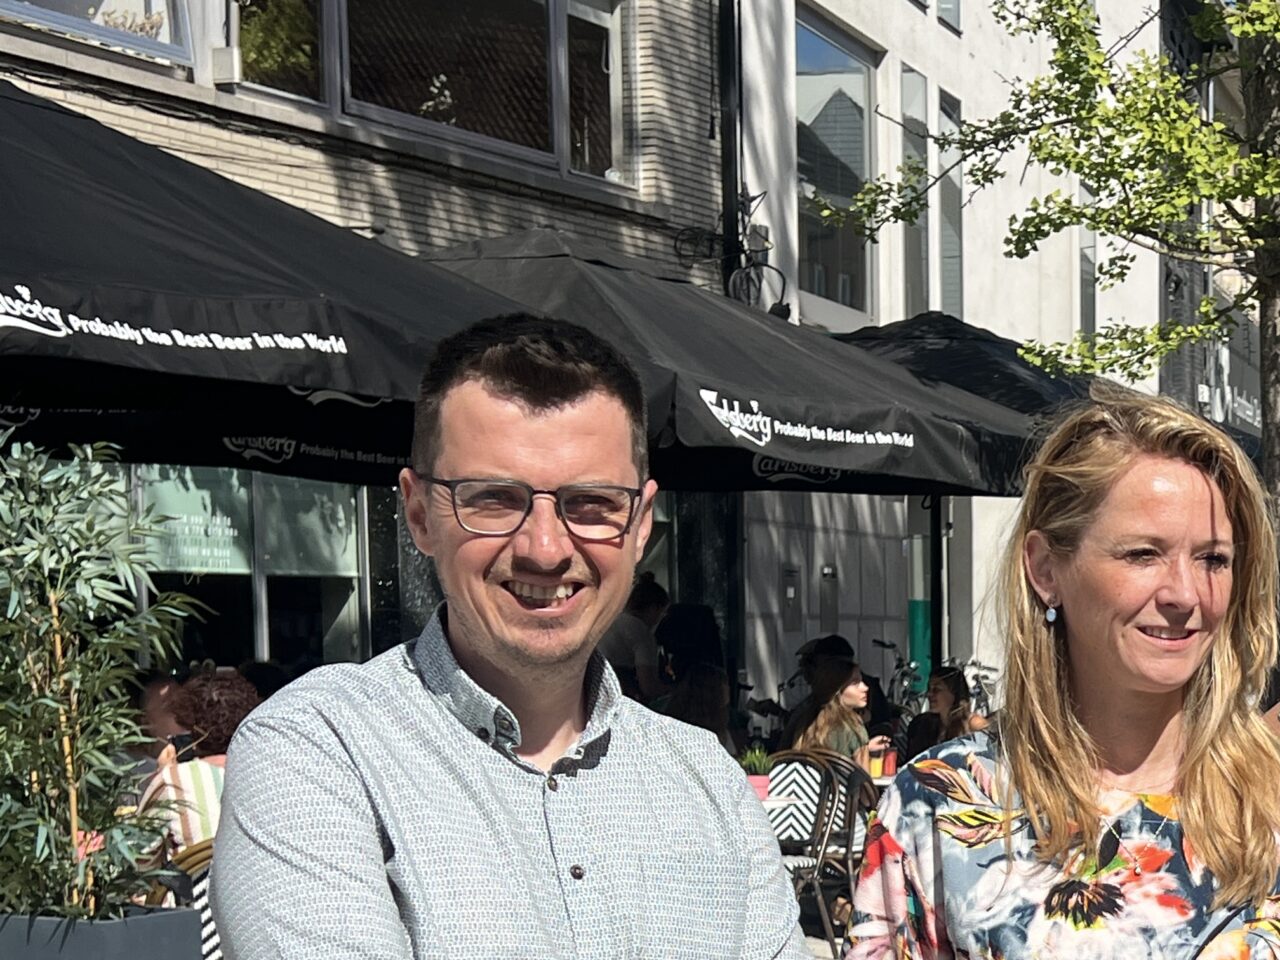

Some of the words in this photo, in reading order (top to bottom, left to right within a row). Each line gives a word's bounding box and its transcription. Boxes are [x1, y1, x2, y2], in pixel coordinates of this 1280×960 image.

[68, 314, 144, 345] Probably
[142, 327, 173, 345] the
[171, 329, 213, 347] Best
[210, 333, 252, 350] Beer
[253, 332, 275, 348] in
[274, 333, 305, 349] the
[302, 332, 348, 353] World
[700, 389, 772, 446] Clsberg
[774, 420, 811, 441] Probably
[811, 426, 826, 441] the
[827, 427, 845, 442] Best
[846, 429, 865, 444] Beer
[875, 431, 893, 445] the
